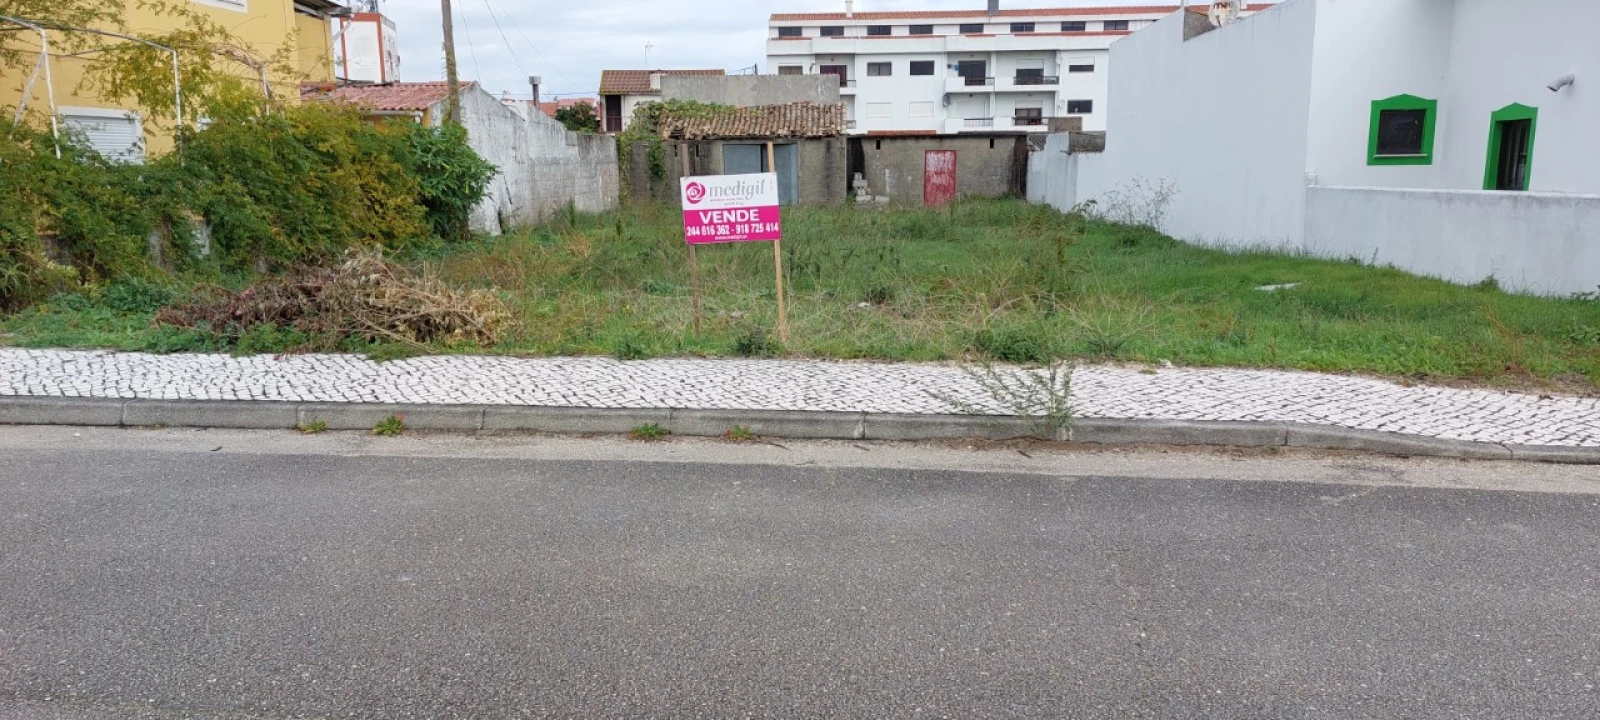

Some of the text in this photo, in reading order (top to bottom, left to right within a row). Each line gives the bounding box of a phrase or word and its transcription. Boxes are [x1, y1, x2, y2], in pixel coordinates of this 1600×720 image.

[709, 179, 765, 200] medigil
[699, 209, 760, 224] VENDE
[686, 226, 700, 236] 244
[701, 225, 715, 235] 616
[736, 223, 749, 234] 918
[751, 223, 764, 233] 725
[766, 222, 779, 232] 414
